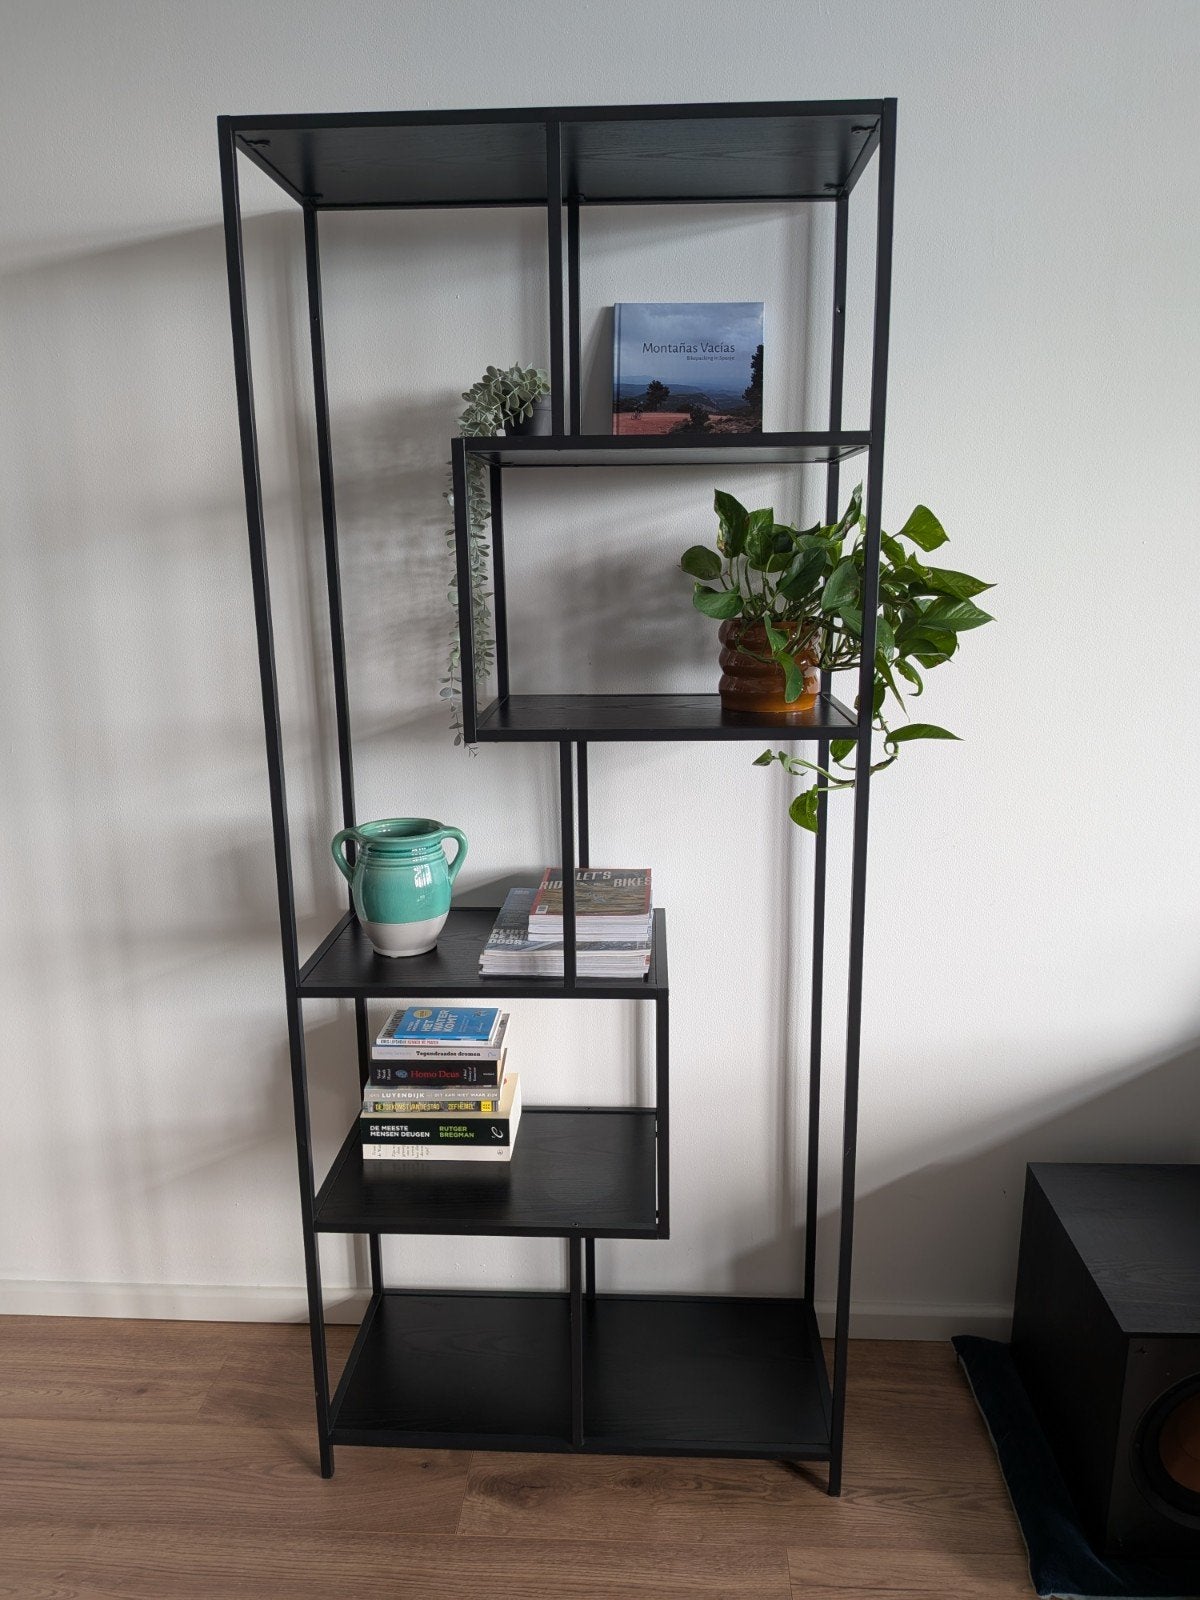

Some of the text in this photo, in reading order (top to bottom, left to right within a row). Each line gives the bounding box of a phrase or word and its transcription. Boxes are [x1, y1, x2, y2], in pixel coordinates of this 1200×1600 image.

[642, 342, 736, 353] Montañas Vacías
[576, 871, 612, 880] LET'S
[539, 880, 564, 890] RID
[613, 877, 652, 887] BIKES
[421, 1019, 434, 1032] HET
[432, 1009, 450, 1032] WATER
[442, 1013, 458, 1033] KOMT
[411, 1070, 437, 1078] Homo
[438, 1070, 460, 1078] Deus
